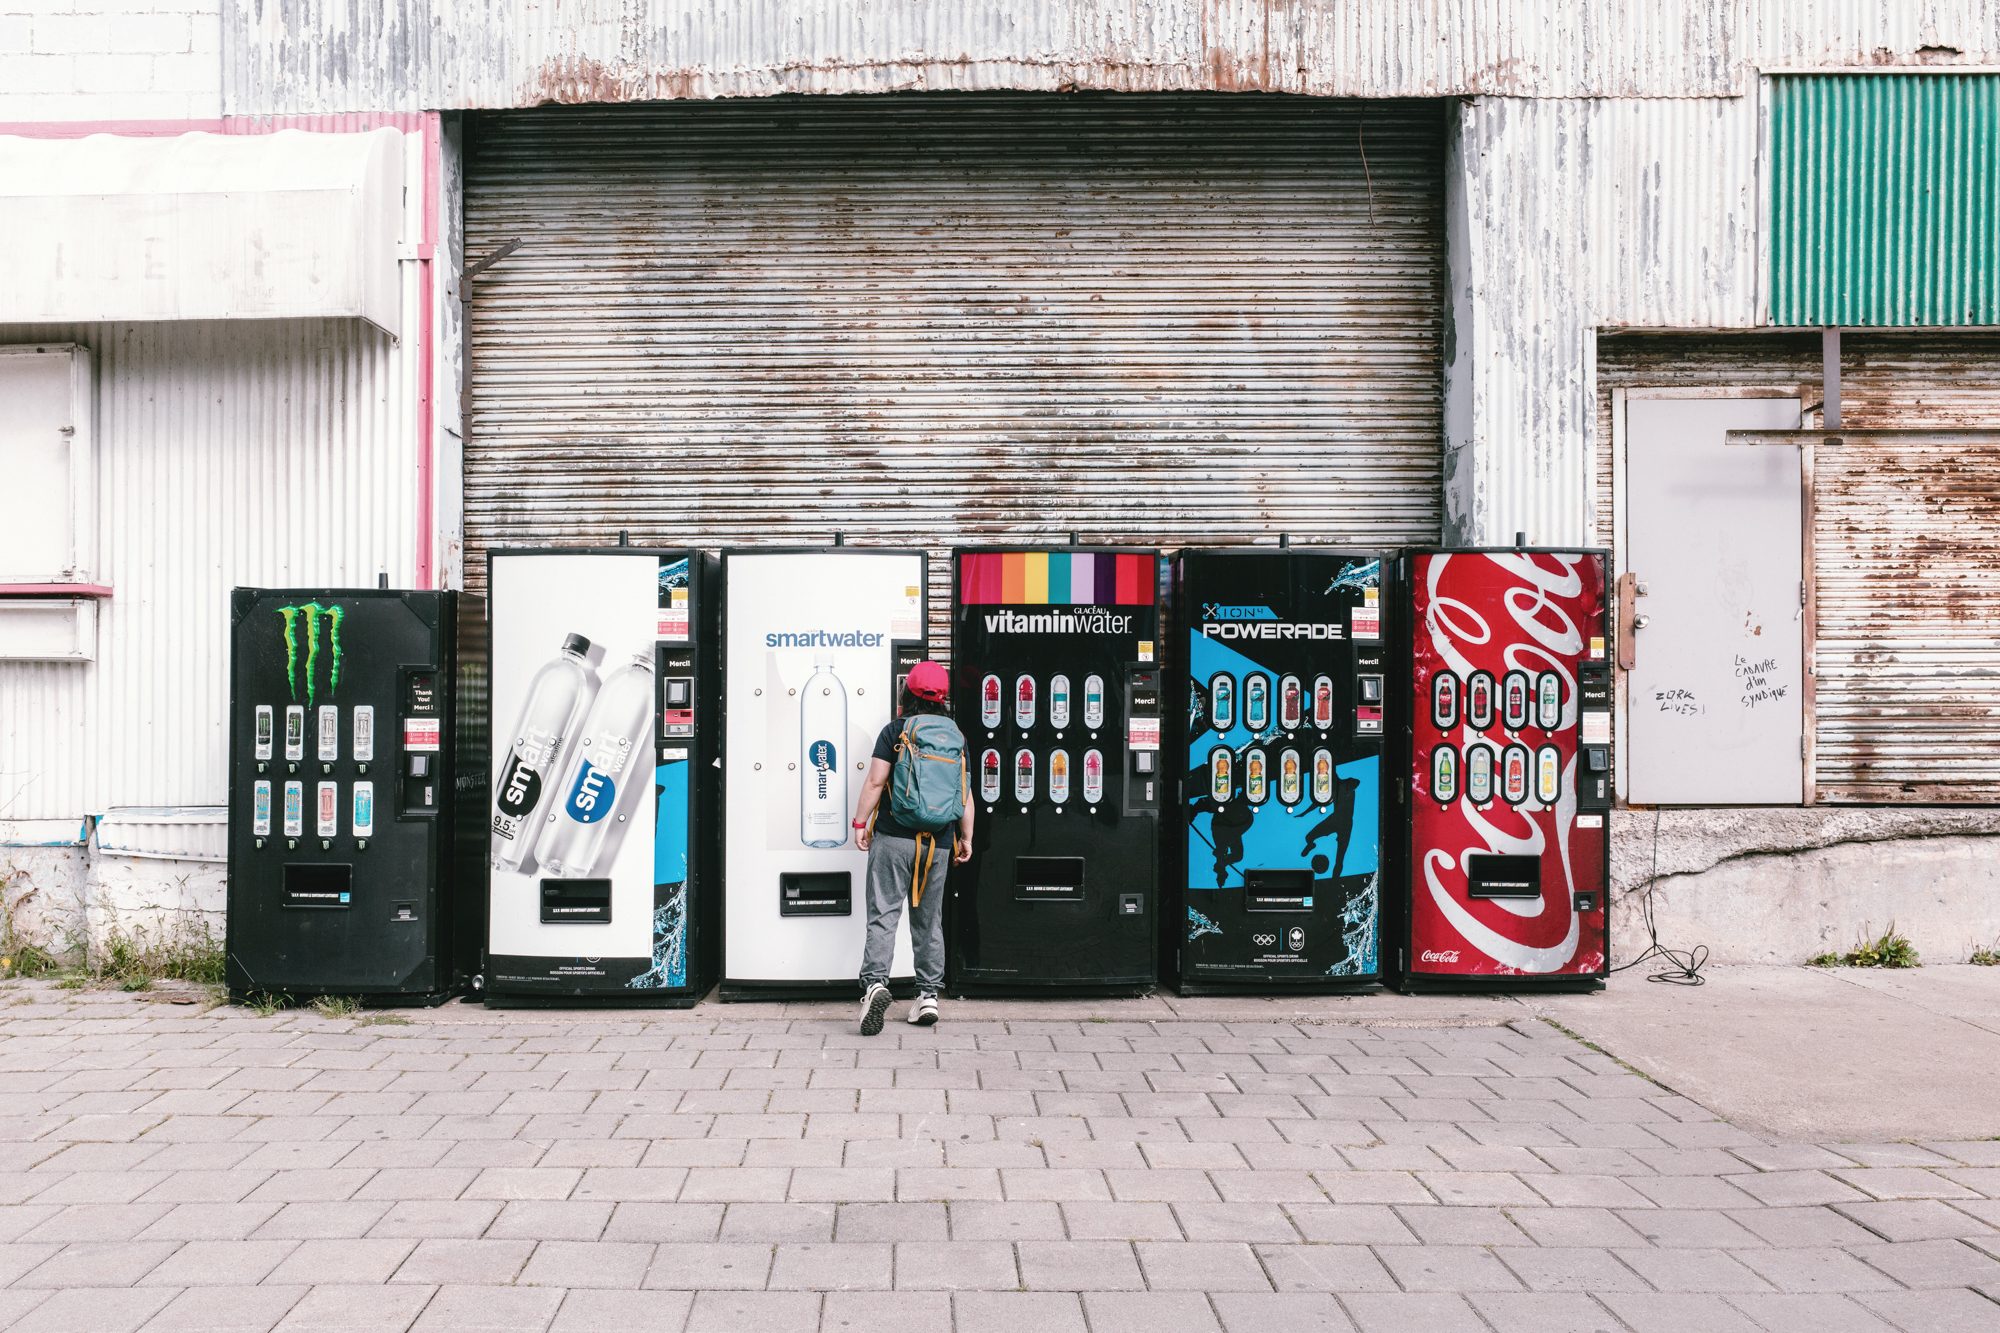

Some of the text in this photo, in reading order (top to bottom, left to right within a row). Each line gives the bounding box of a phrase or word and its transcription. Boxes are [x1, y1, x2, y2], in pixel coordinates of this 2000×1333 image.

[1073, 605, 1107, 615] GLACÉAU
[984, 609, 1132, 634] vitaminwater
[765, 629, 884, 648] smartwater
[1202, 623, 1343, 640] POWERADE
[1735, 654, 1747, 666] Le
[1735, 659, 1778, 678] CADAVRE
[1746, 676, 1767, 691] d'un
[1656, 689, 1695, 700] ZORK
[538, 734, 558, 767] watr
[506, 725, 550, 806] smart
[575, 729, 619, 812] smart
[1421, 949, 1461, 963] Coca-Cola
